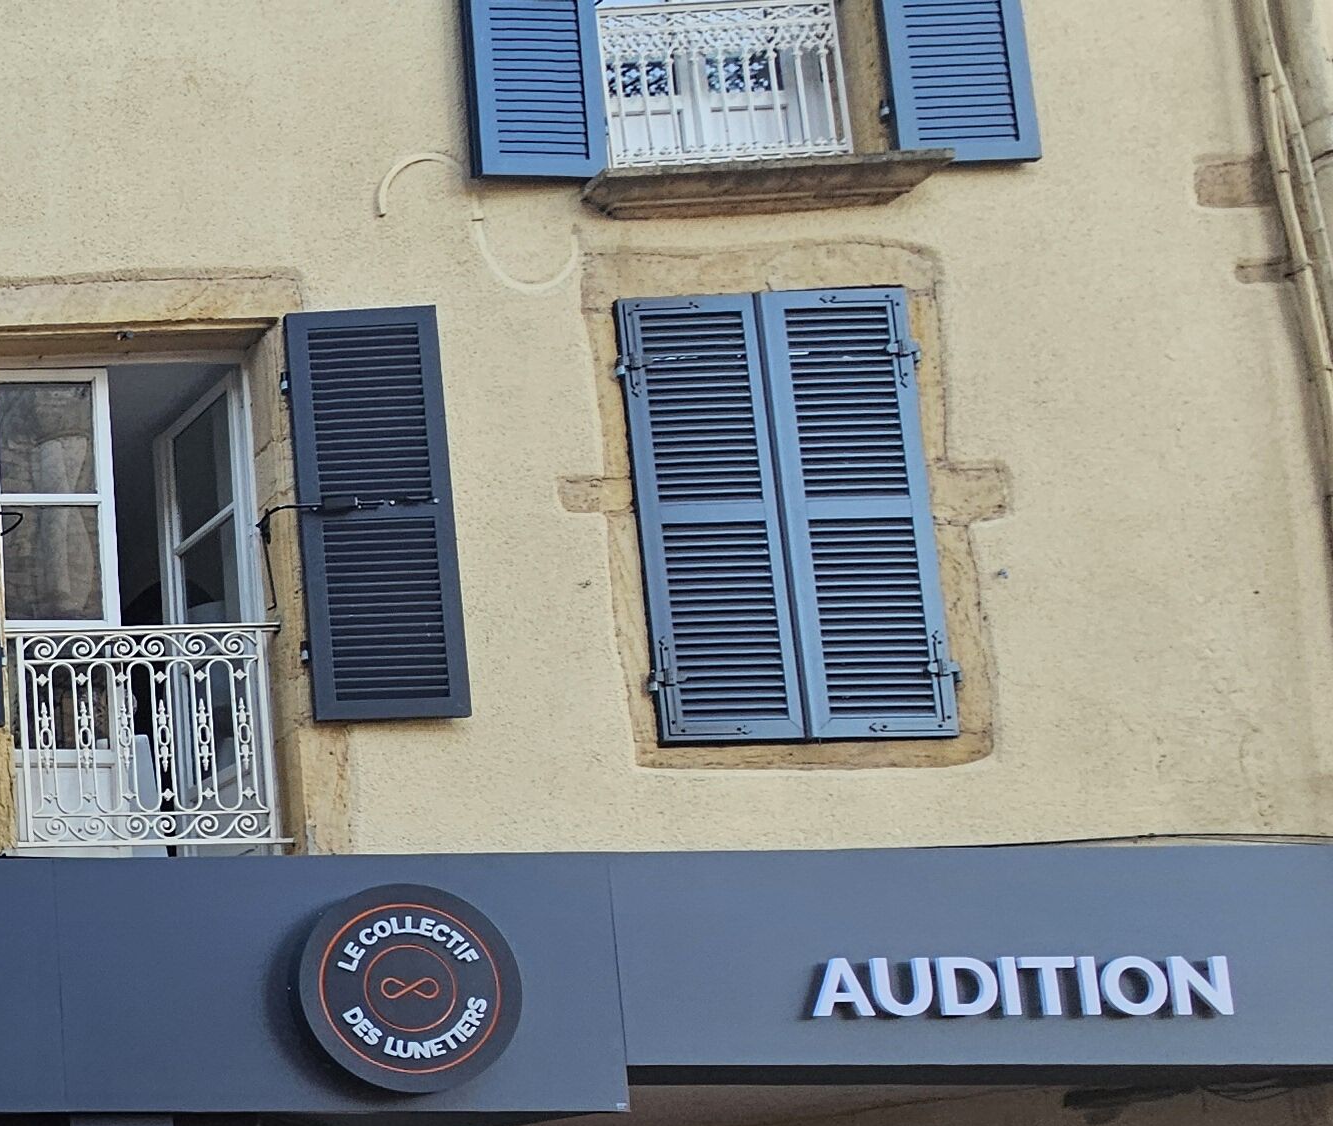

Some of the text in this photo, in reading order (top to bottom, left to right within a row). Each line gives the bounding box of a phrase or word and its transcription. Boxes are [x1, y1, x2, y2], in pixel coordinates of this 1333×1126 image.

[337, 915, 480, 973] LE COLLECTIF
[813, 956, 1234, 1016] AUDITION
[342, 997, 487, 1059] DES LUNETIERS
